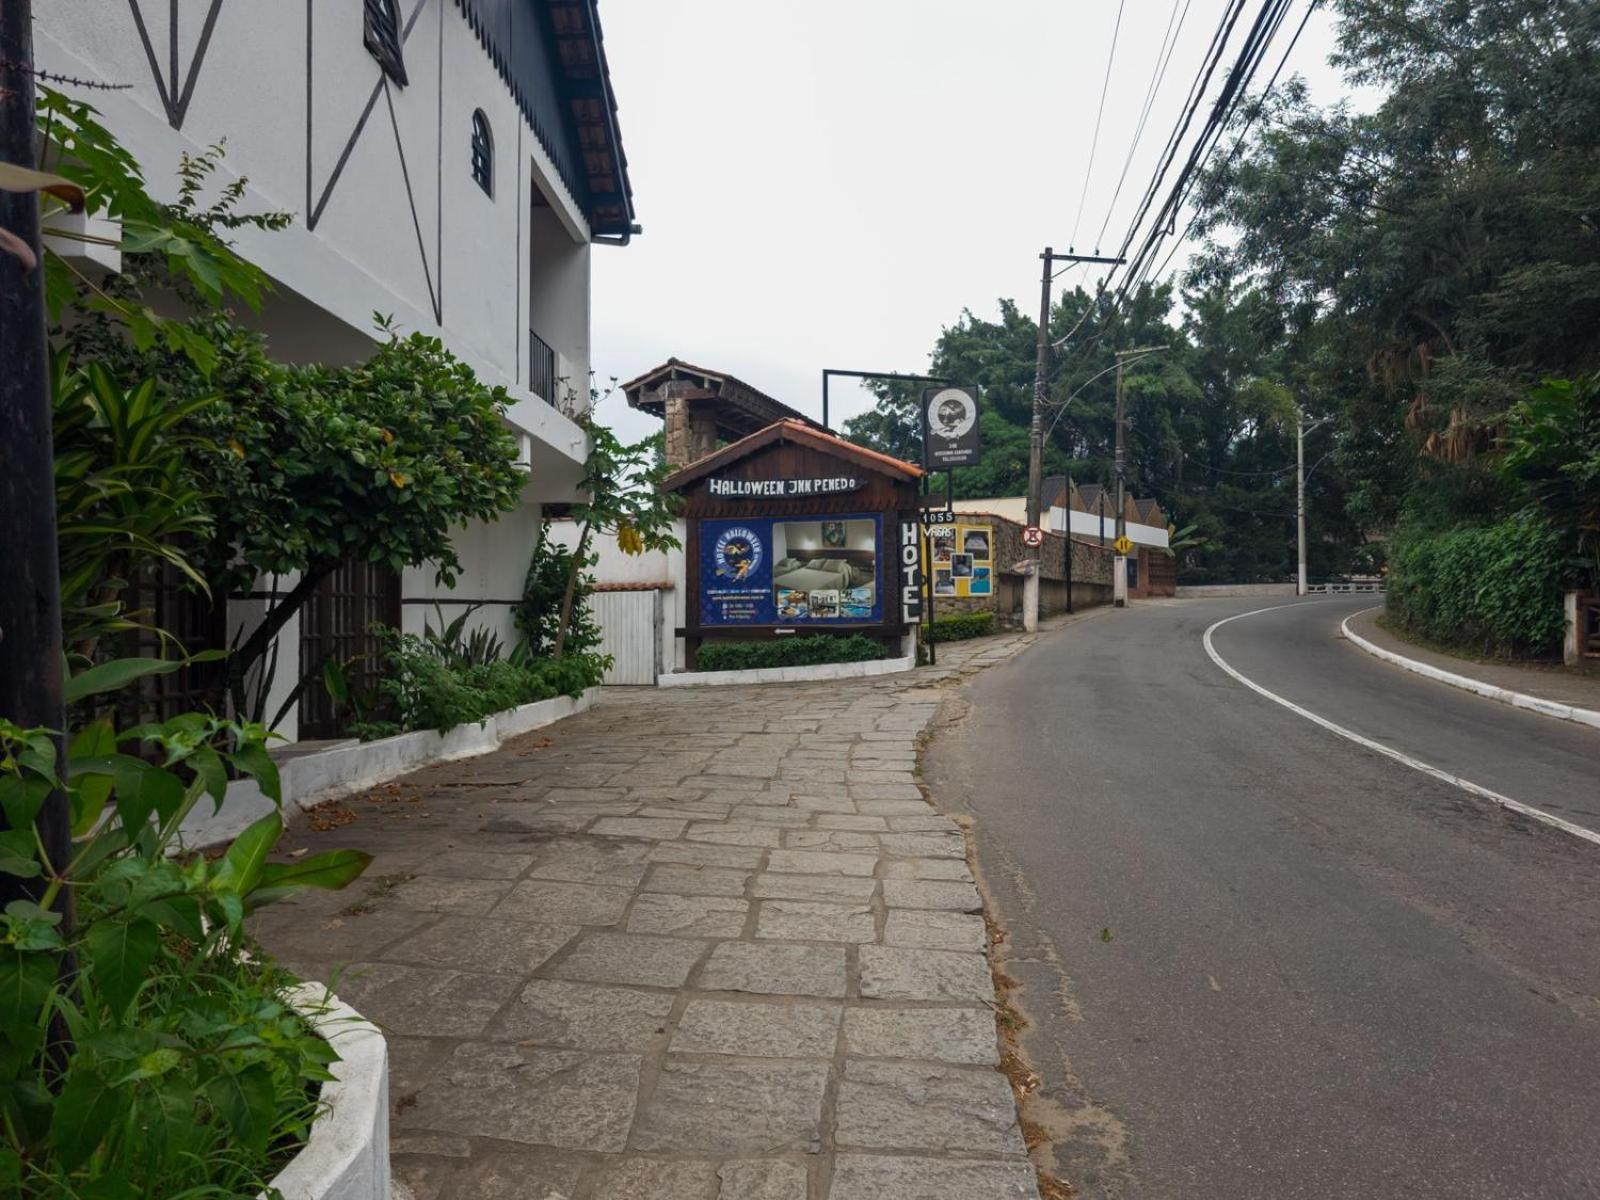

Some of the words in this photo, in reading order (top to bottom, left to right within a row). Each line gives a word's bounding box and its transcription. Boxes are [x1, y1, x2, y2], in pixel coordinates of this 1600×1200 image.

[709, 478, 784, 495] HALLOWEEN
[814, 478, 856, 492] PENEDO
[923, 512, 953, 523] 1055
[924, 527, 952, 538] VAGAS
[902, 522, 920, 623] HOTEL
